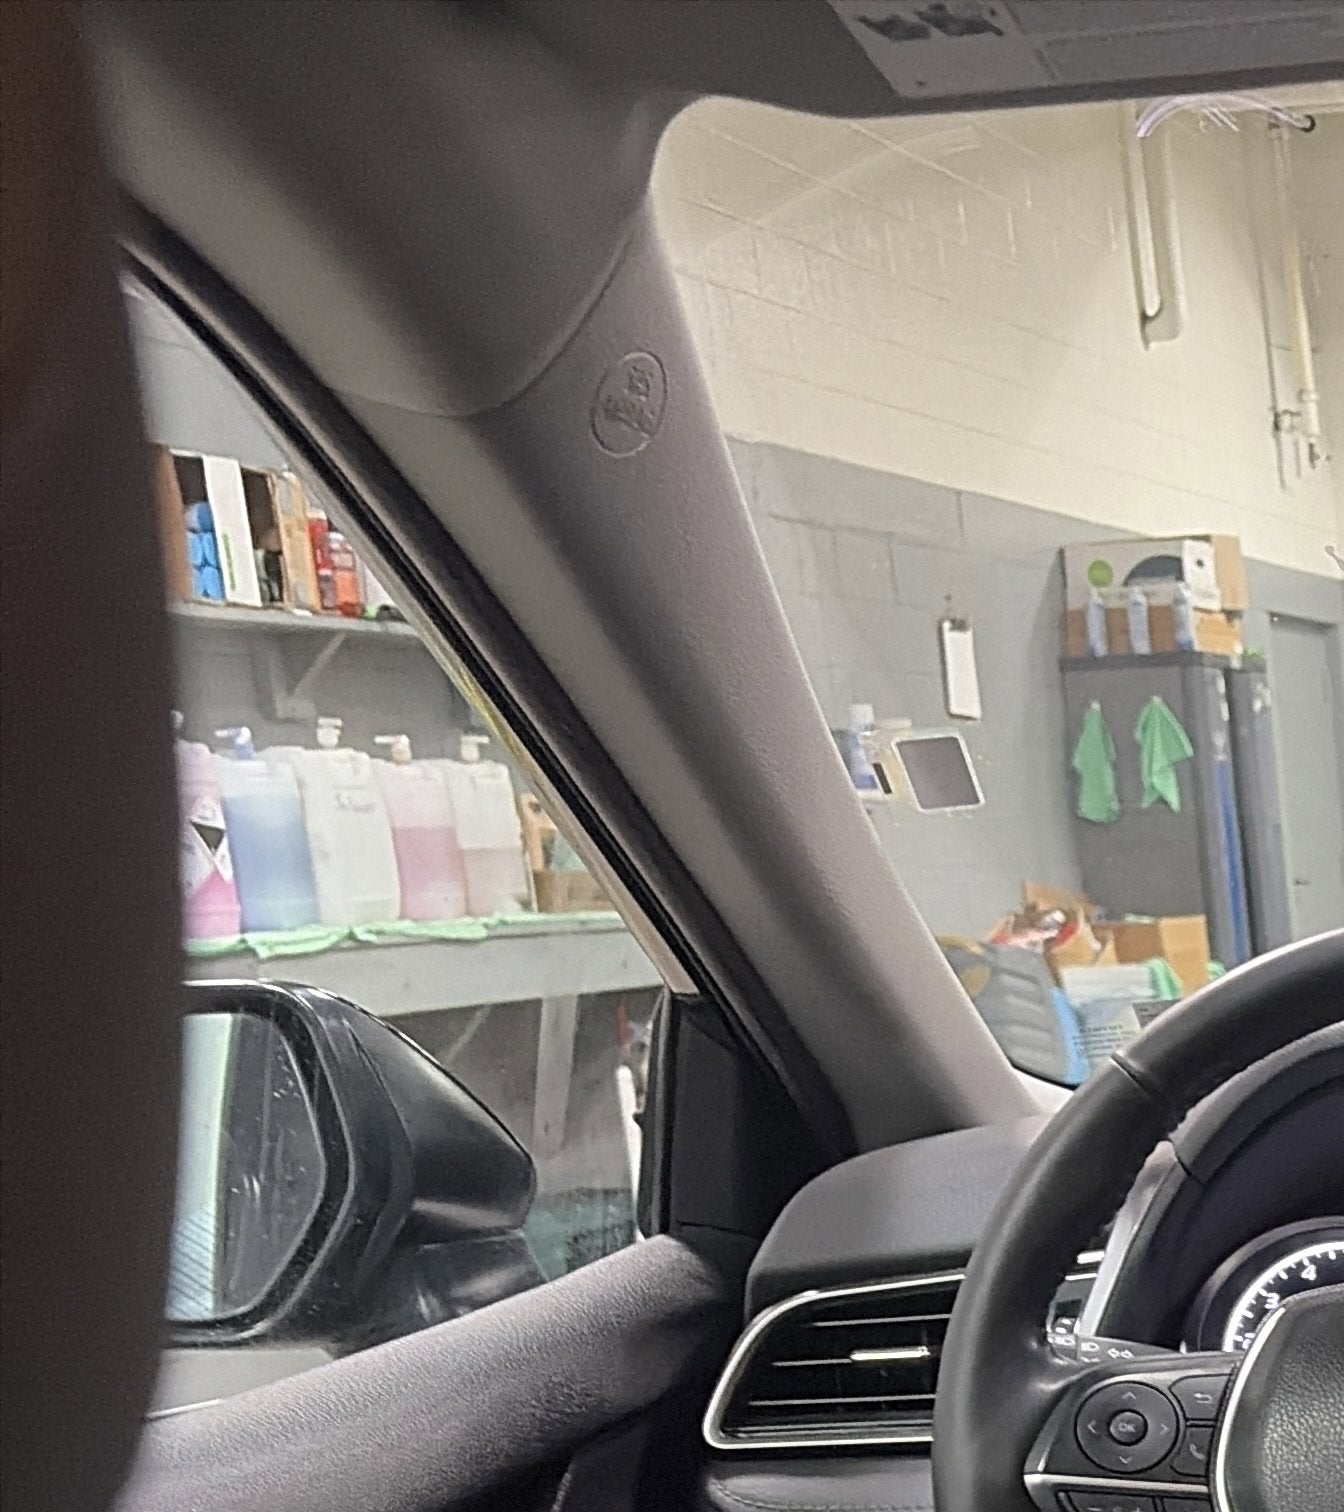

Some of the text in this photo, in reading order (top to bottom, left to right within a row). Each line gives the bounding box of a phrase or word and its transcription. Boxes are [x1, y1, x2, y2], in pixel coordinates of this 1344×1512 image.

[1301, 1264, 1317, 1281] 4
[1264, 1292, 1280, 1309] 3
[1118, 1422, 1136, 1433] OK
